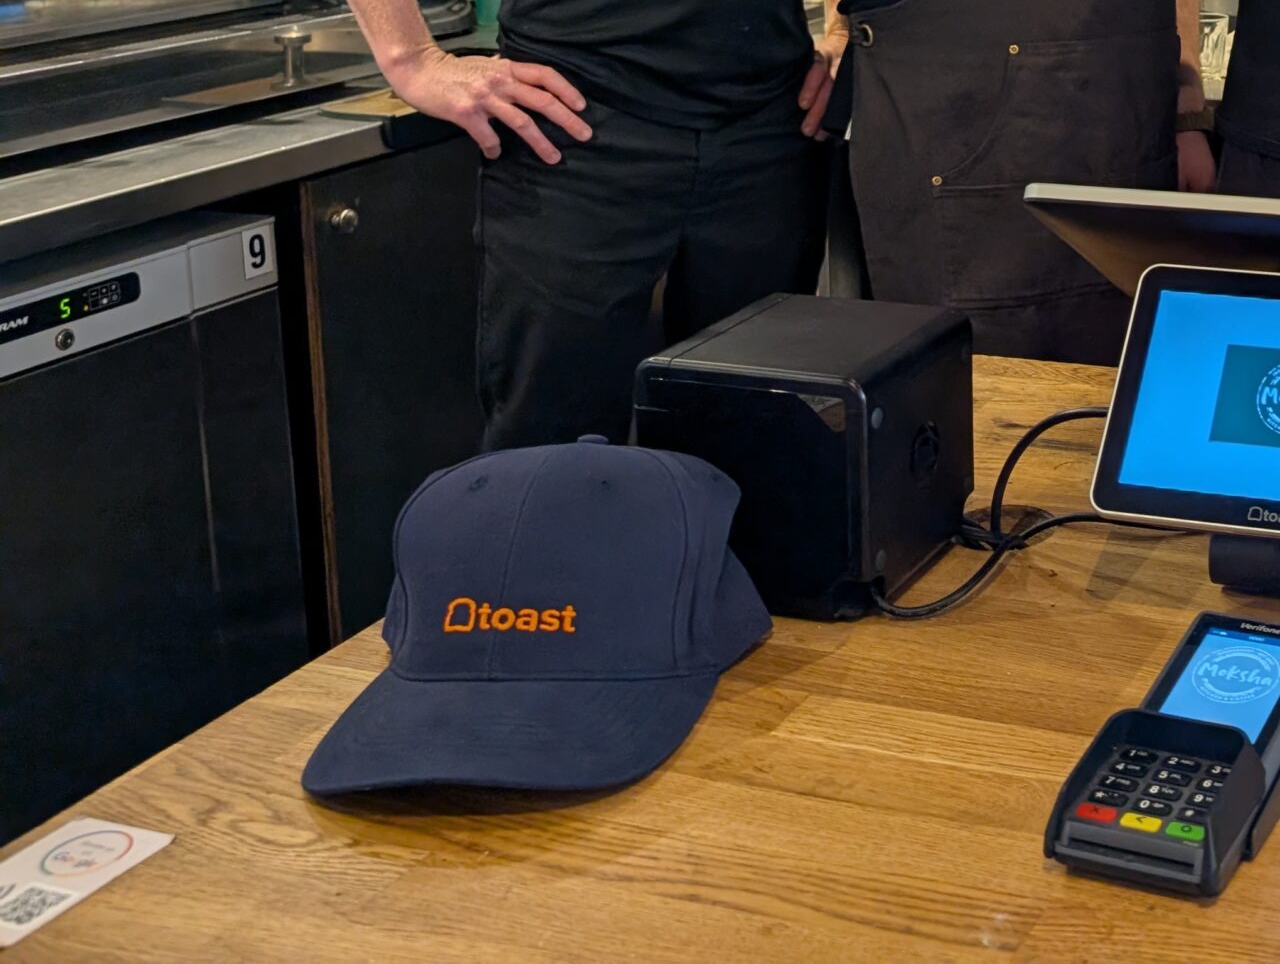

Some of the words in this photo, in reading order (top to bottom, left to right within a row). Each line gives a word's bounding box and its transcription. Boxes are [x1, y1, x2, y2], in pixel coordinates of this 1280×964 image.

[249, 234, 266, 269] 9
[60, 298, 71, 318] 5
[478, 602, 577, 633] toast
[1198, 662, 1272, 686] Moksha
[1168, 757, 1179, 765] 2
[1115, 762, 1126, 770] 4
[1211, 766, 1222, 774] 3
[1158, 770, 1169, 779] 5
[1105, 776, 1116, 785] 7
[1202, 779, 1213, 788] 6
[1149, 785, 1160, 794] 8
[1193, 794, 1204, 803] 9
[1139, 800, 1150, 809] 0
